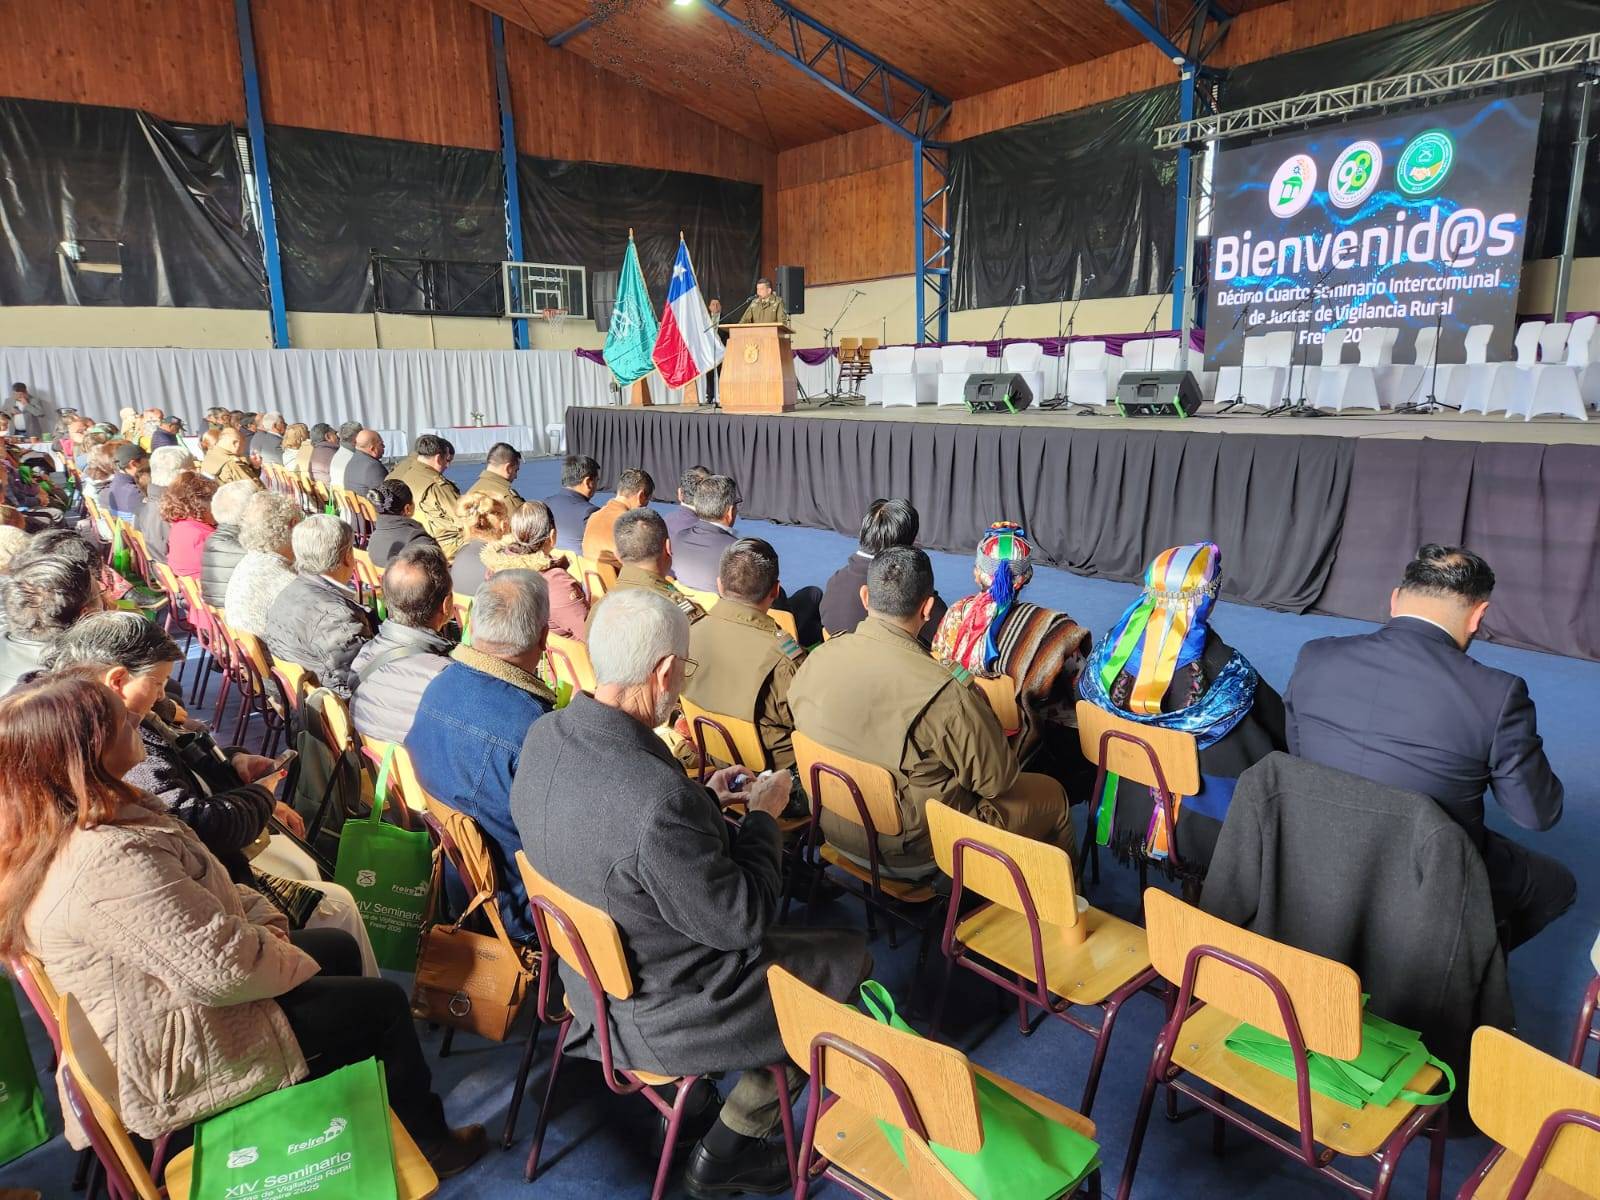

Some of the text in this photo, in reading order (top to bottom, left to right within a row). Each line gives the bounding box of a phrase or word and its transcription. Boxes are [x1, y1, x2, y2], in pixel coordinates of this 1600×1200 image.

[1214, 205, 1516, 281] Bienvenid@s
[1217, 268, 1500, 306] Décimo Cuarto Seminario Intercomunal
[1249, 297, 1453, 326] de Juntas de Vigilancia Rural
[1299, 329, 1327, 345] Frei
[288, 1135, 325, 1153] Freire
[224, 1152, 352, 1198] XIV Seminario
